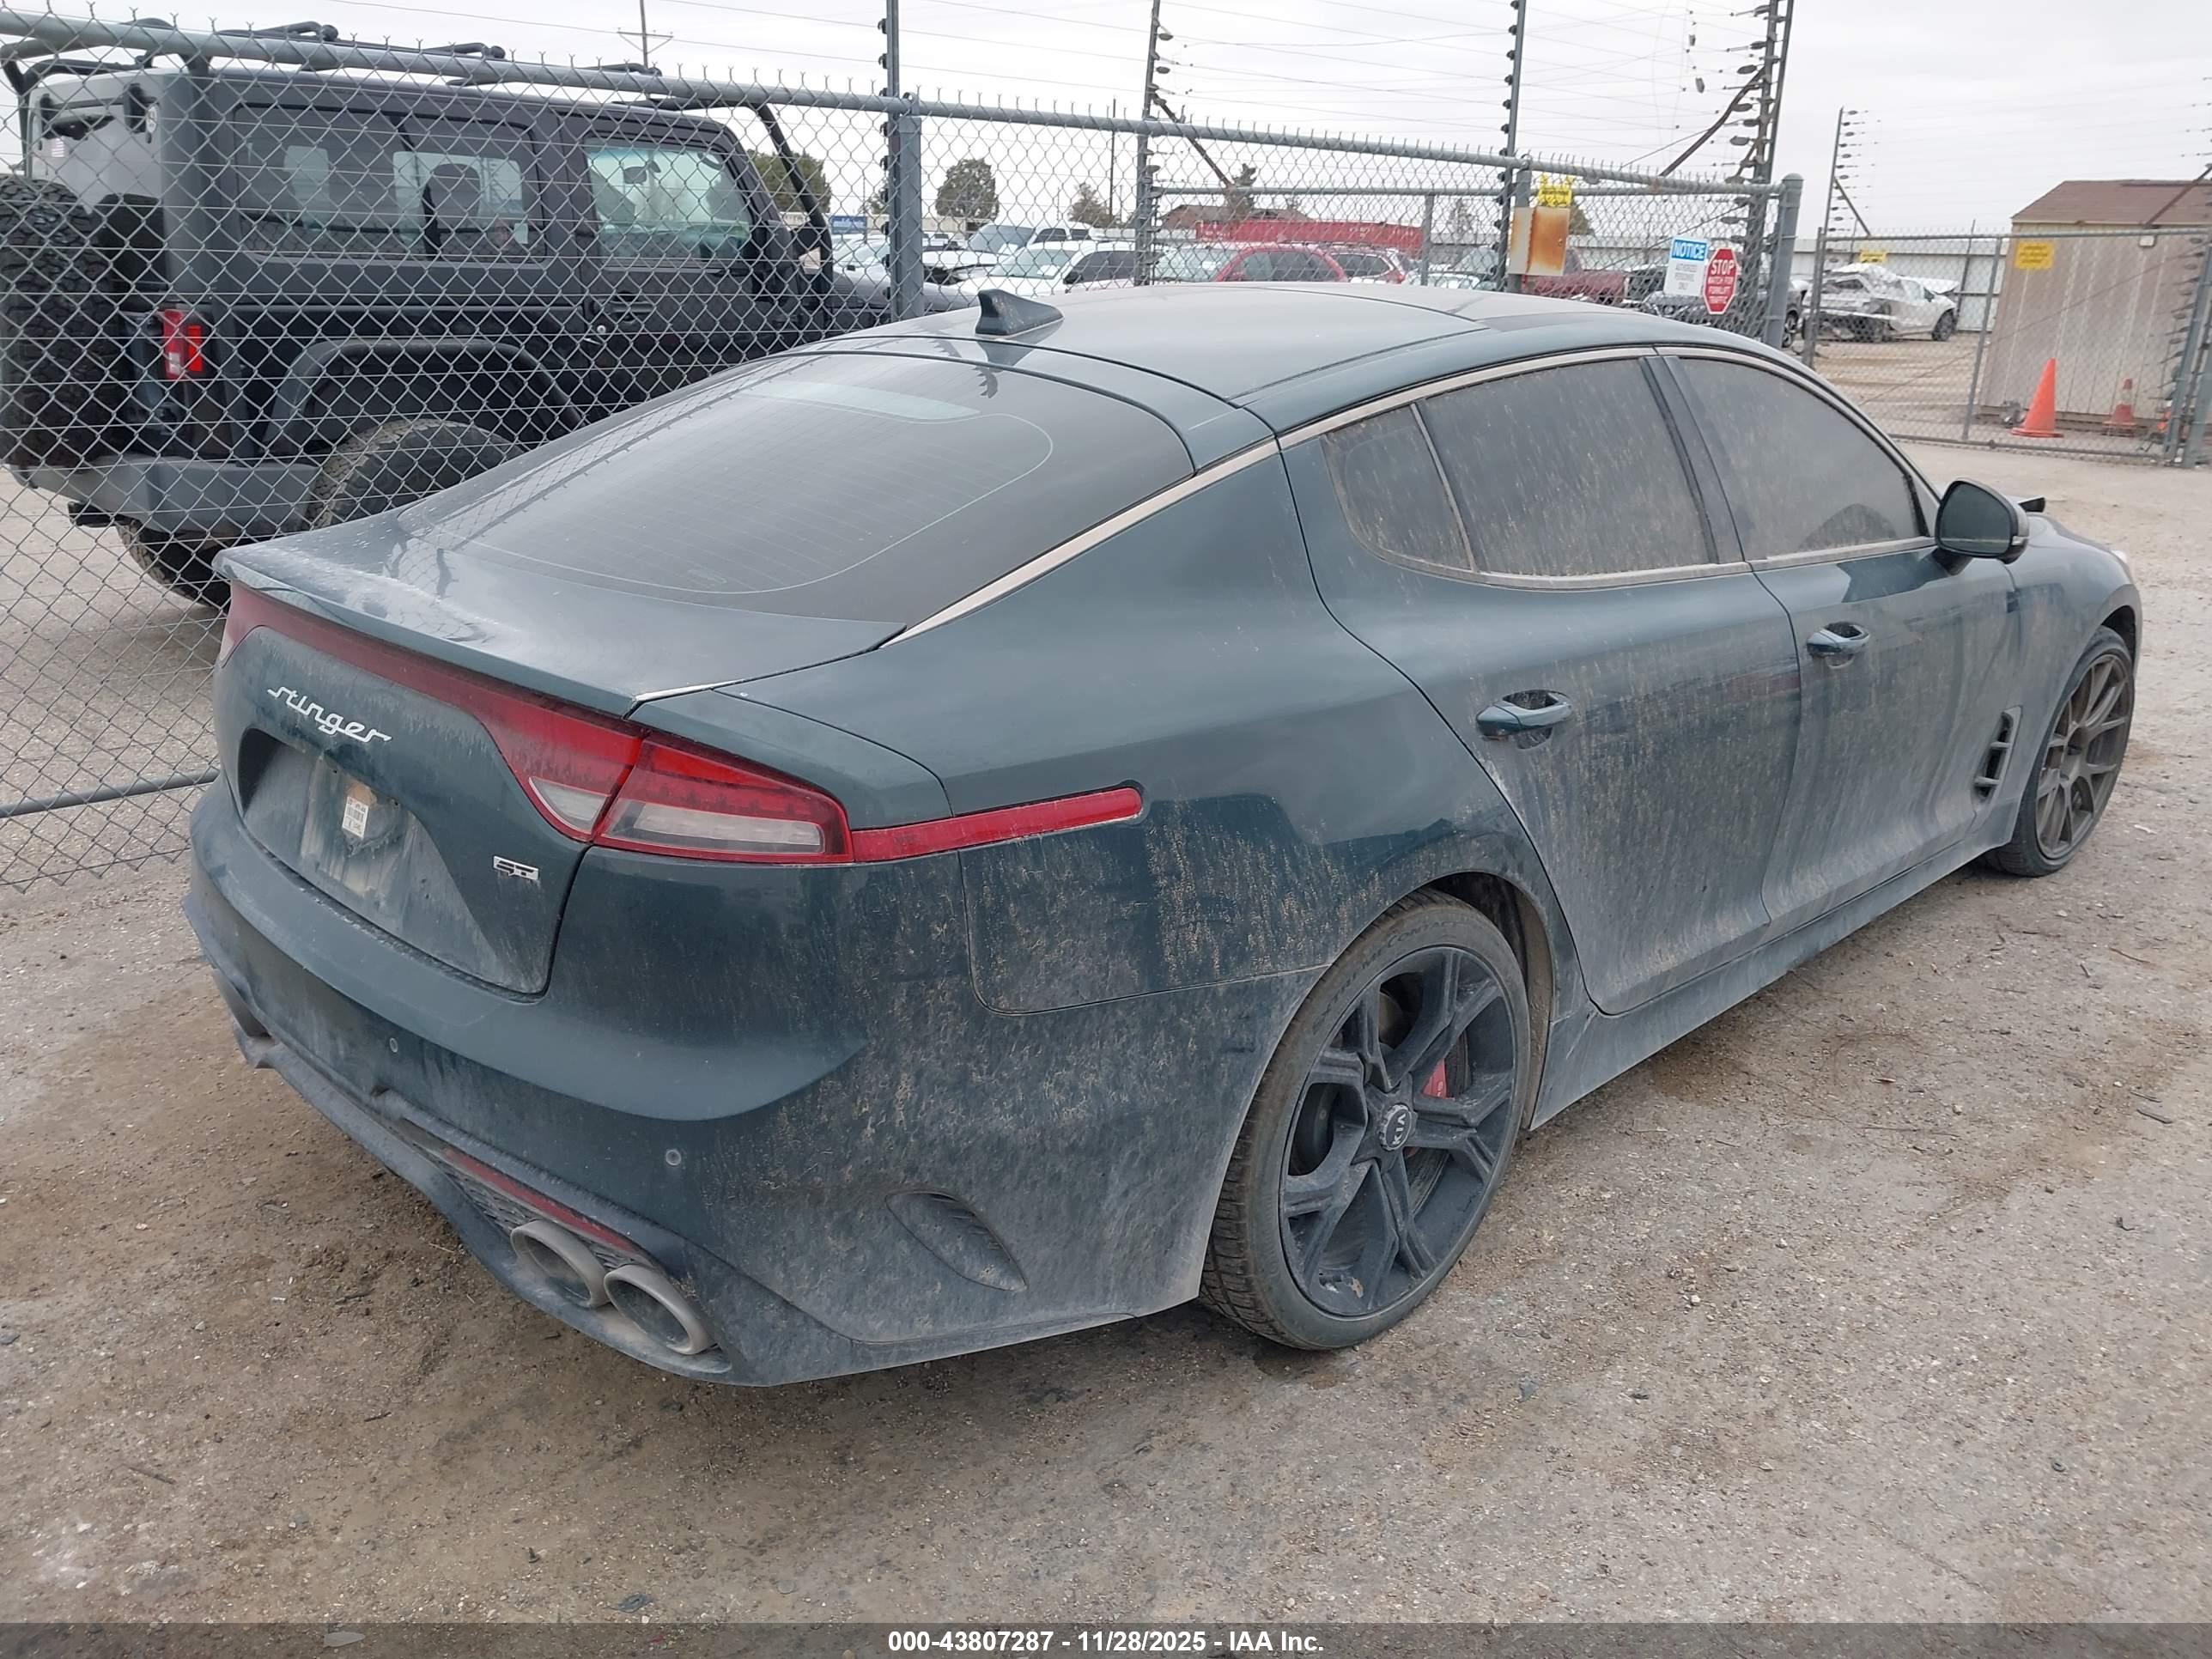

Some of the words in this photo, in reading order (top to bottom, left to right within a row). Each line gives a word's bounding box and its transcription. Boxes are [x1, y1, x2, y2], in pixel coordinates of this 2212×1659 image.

[1672, 241, 1705, 259] NOTICE
[1710, 259, 1735, 275] STOP
[1391, 1113, 1407, 1145] KIA
